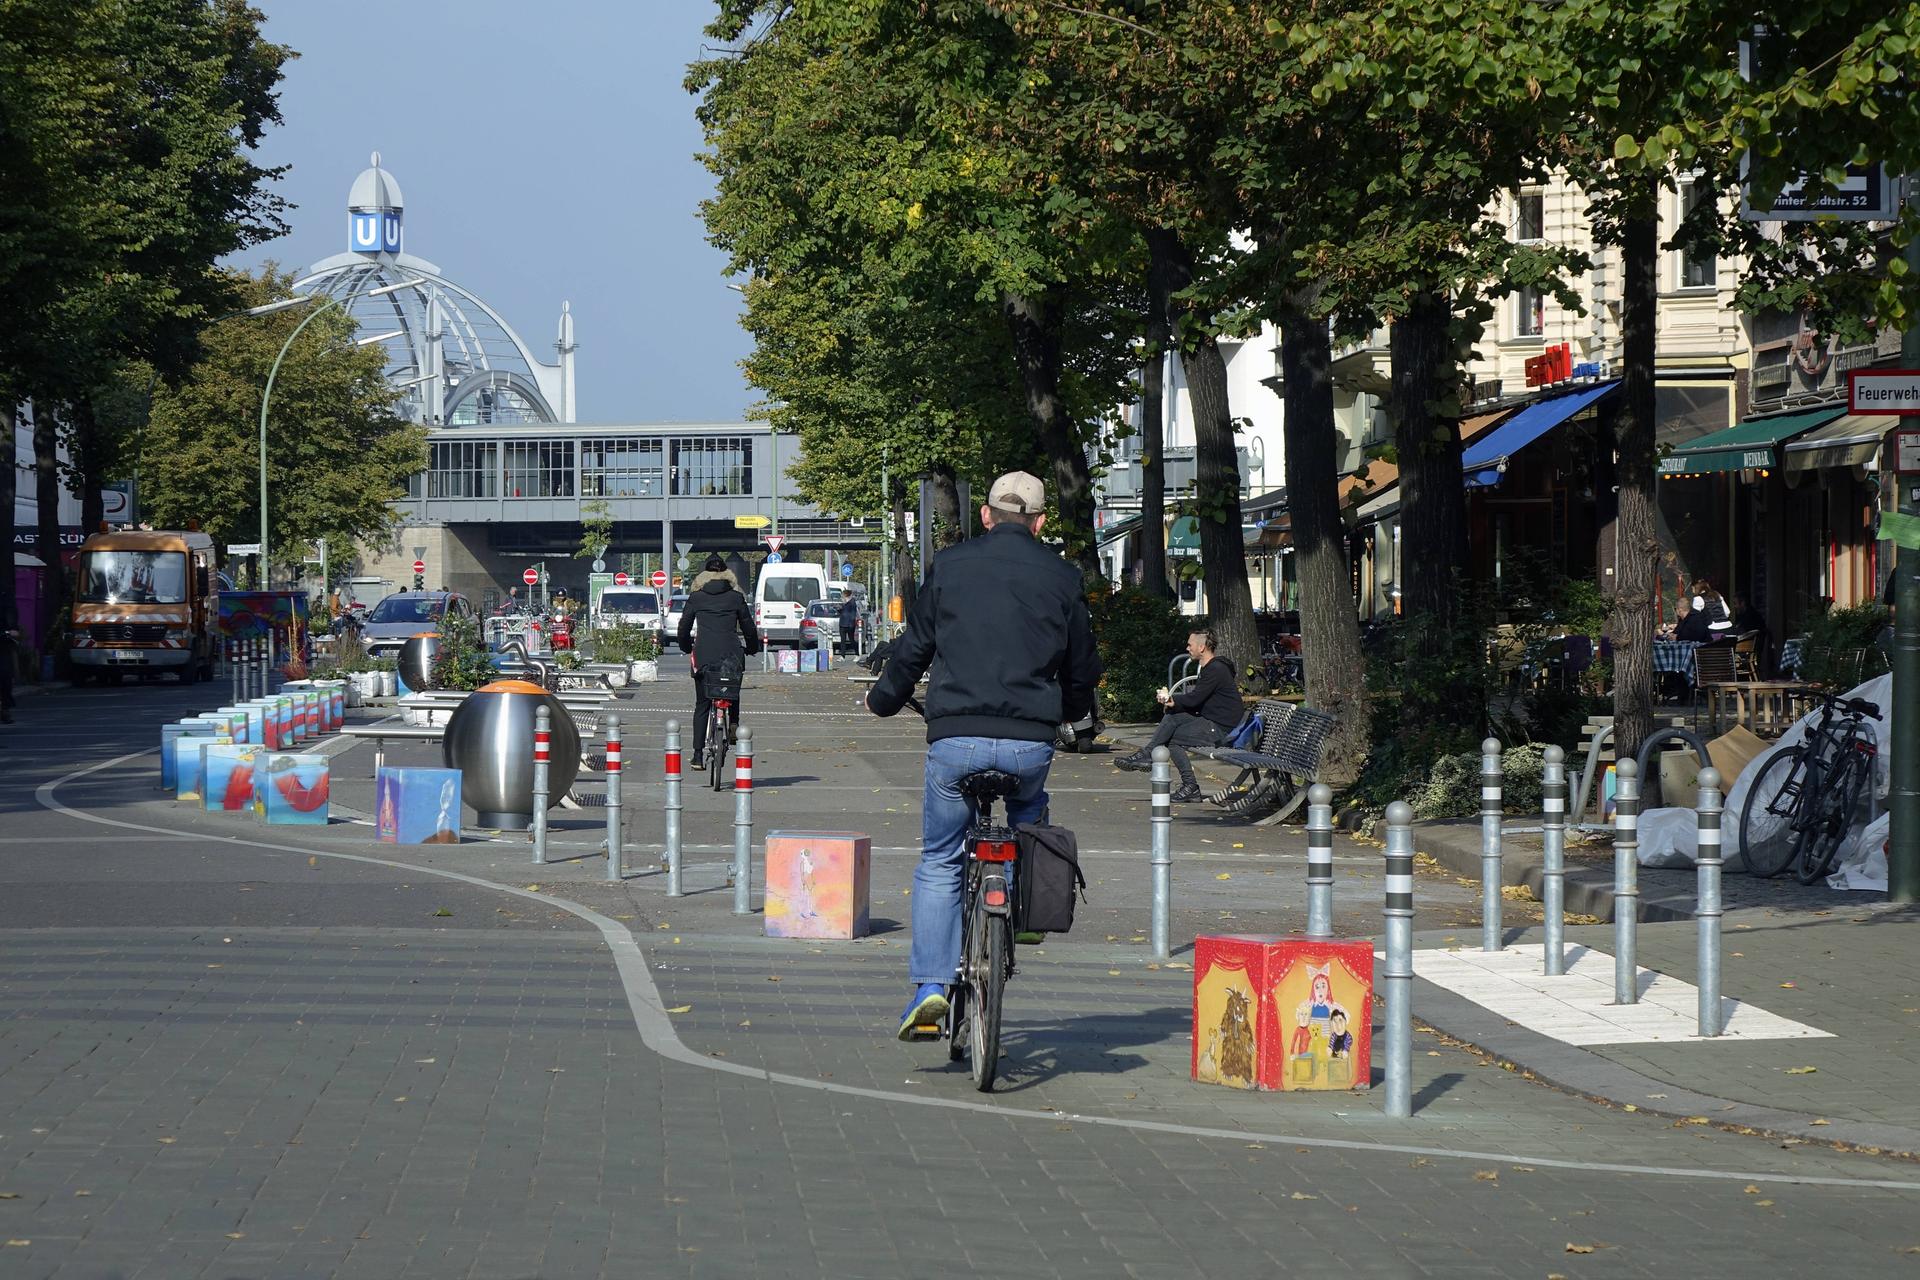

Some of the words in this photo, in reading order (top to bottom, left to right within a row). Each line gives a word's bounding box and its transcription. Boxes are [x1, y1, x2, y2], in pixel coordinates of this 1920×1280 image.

[1852, 195, 1868, 206] 52
[357, 218, 376, 246] U
[385, 218, 399, 246] U
[1858, 385, 1920, 401] Feuerweh
